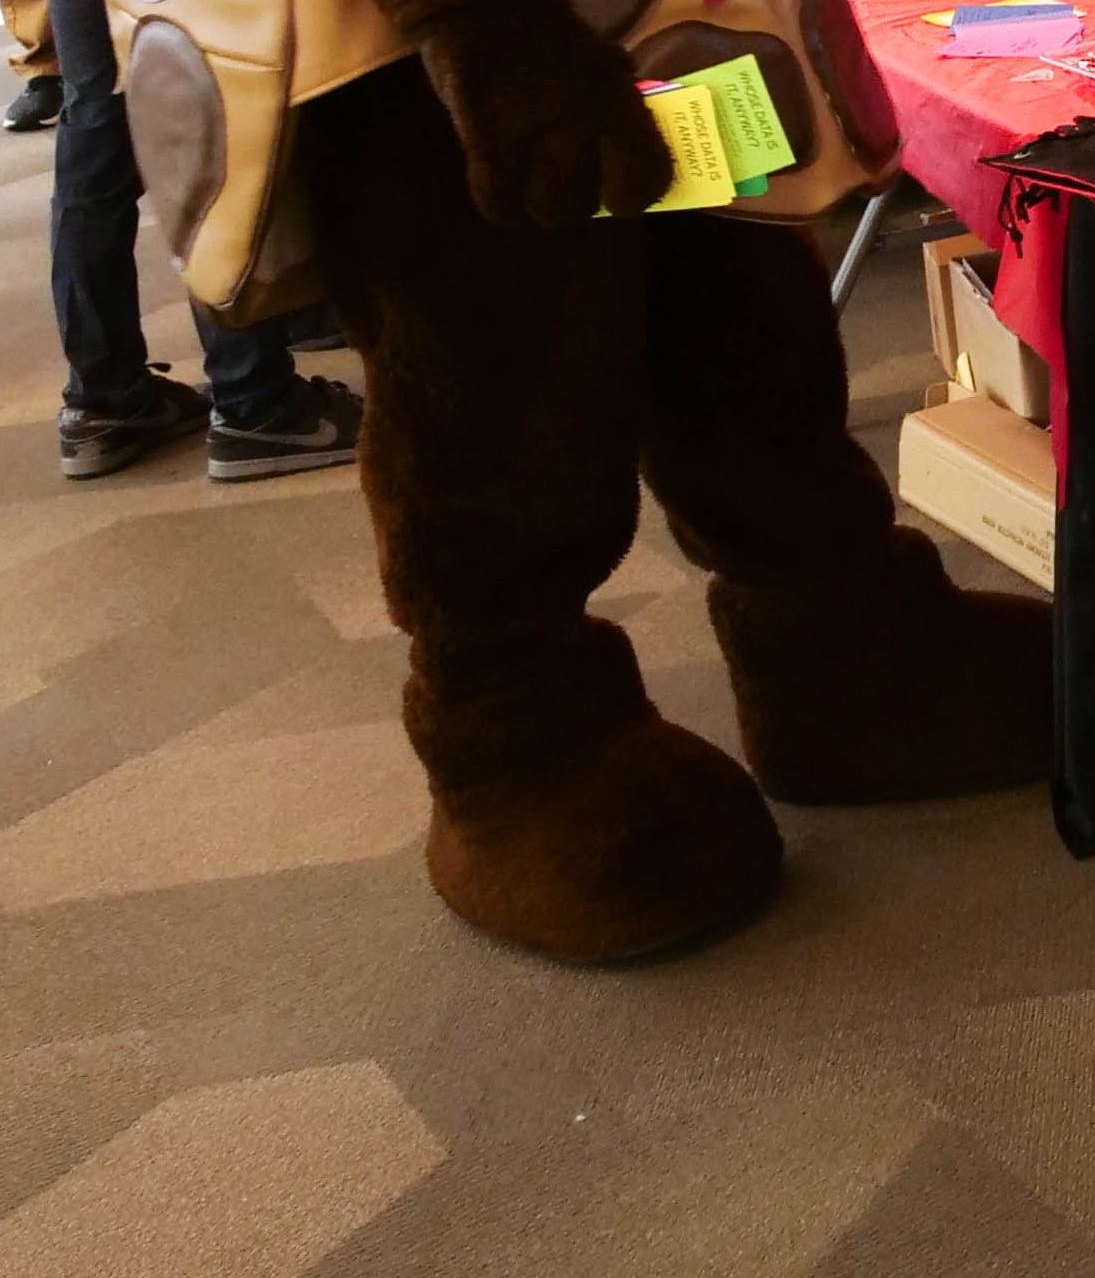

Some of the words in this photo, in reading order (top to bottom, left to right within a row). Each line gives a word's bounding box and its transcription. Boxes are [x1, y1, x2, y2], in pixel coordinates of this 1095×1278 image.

[688, 99, 709, 140] WHOSE
[701, 139, 717, 169] DATA
[710, 170, 721, 181] IS
[738, 70, 762, 111] WHOSE
[754, 110, 773, 138] DATA
[767, 139, 779, 150] IS
[678, 126, 704, 178] ANYWAY?
